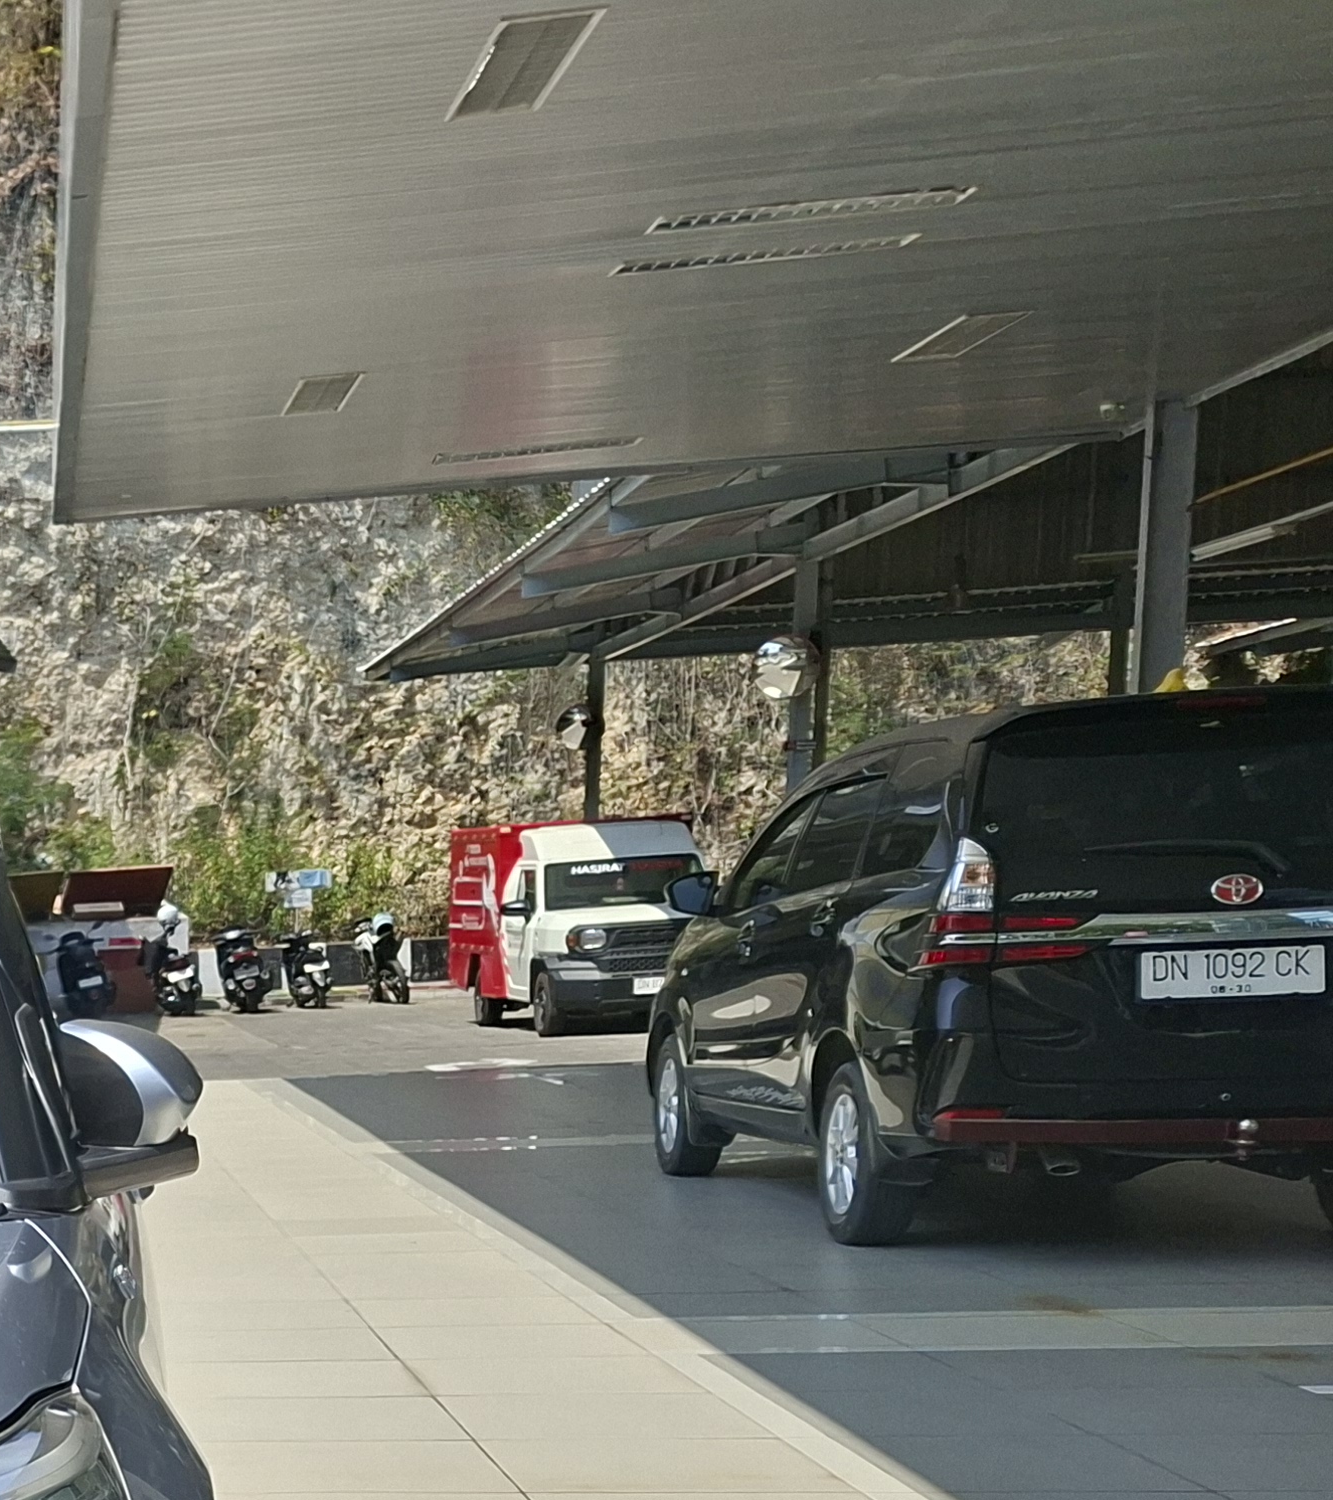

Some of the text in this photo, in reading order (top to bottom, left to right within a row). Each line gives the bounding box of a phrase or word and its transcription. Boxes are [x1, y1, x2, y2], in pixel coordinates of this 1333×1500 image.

[1009, 889, 1099, 902] AVANZA
[1152, 949, 1310, 982] DN 1092 CK
